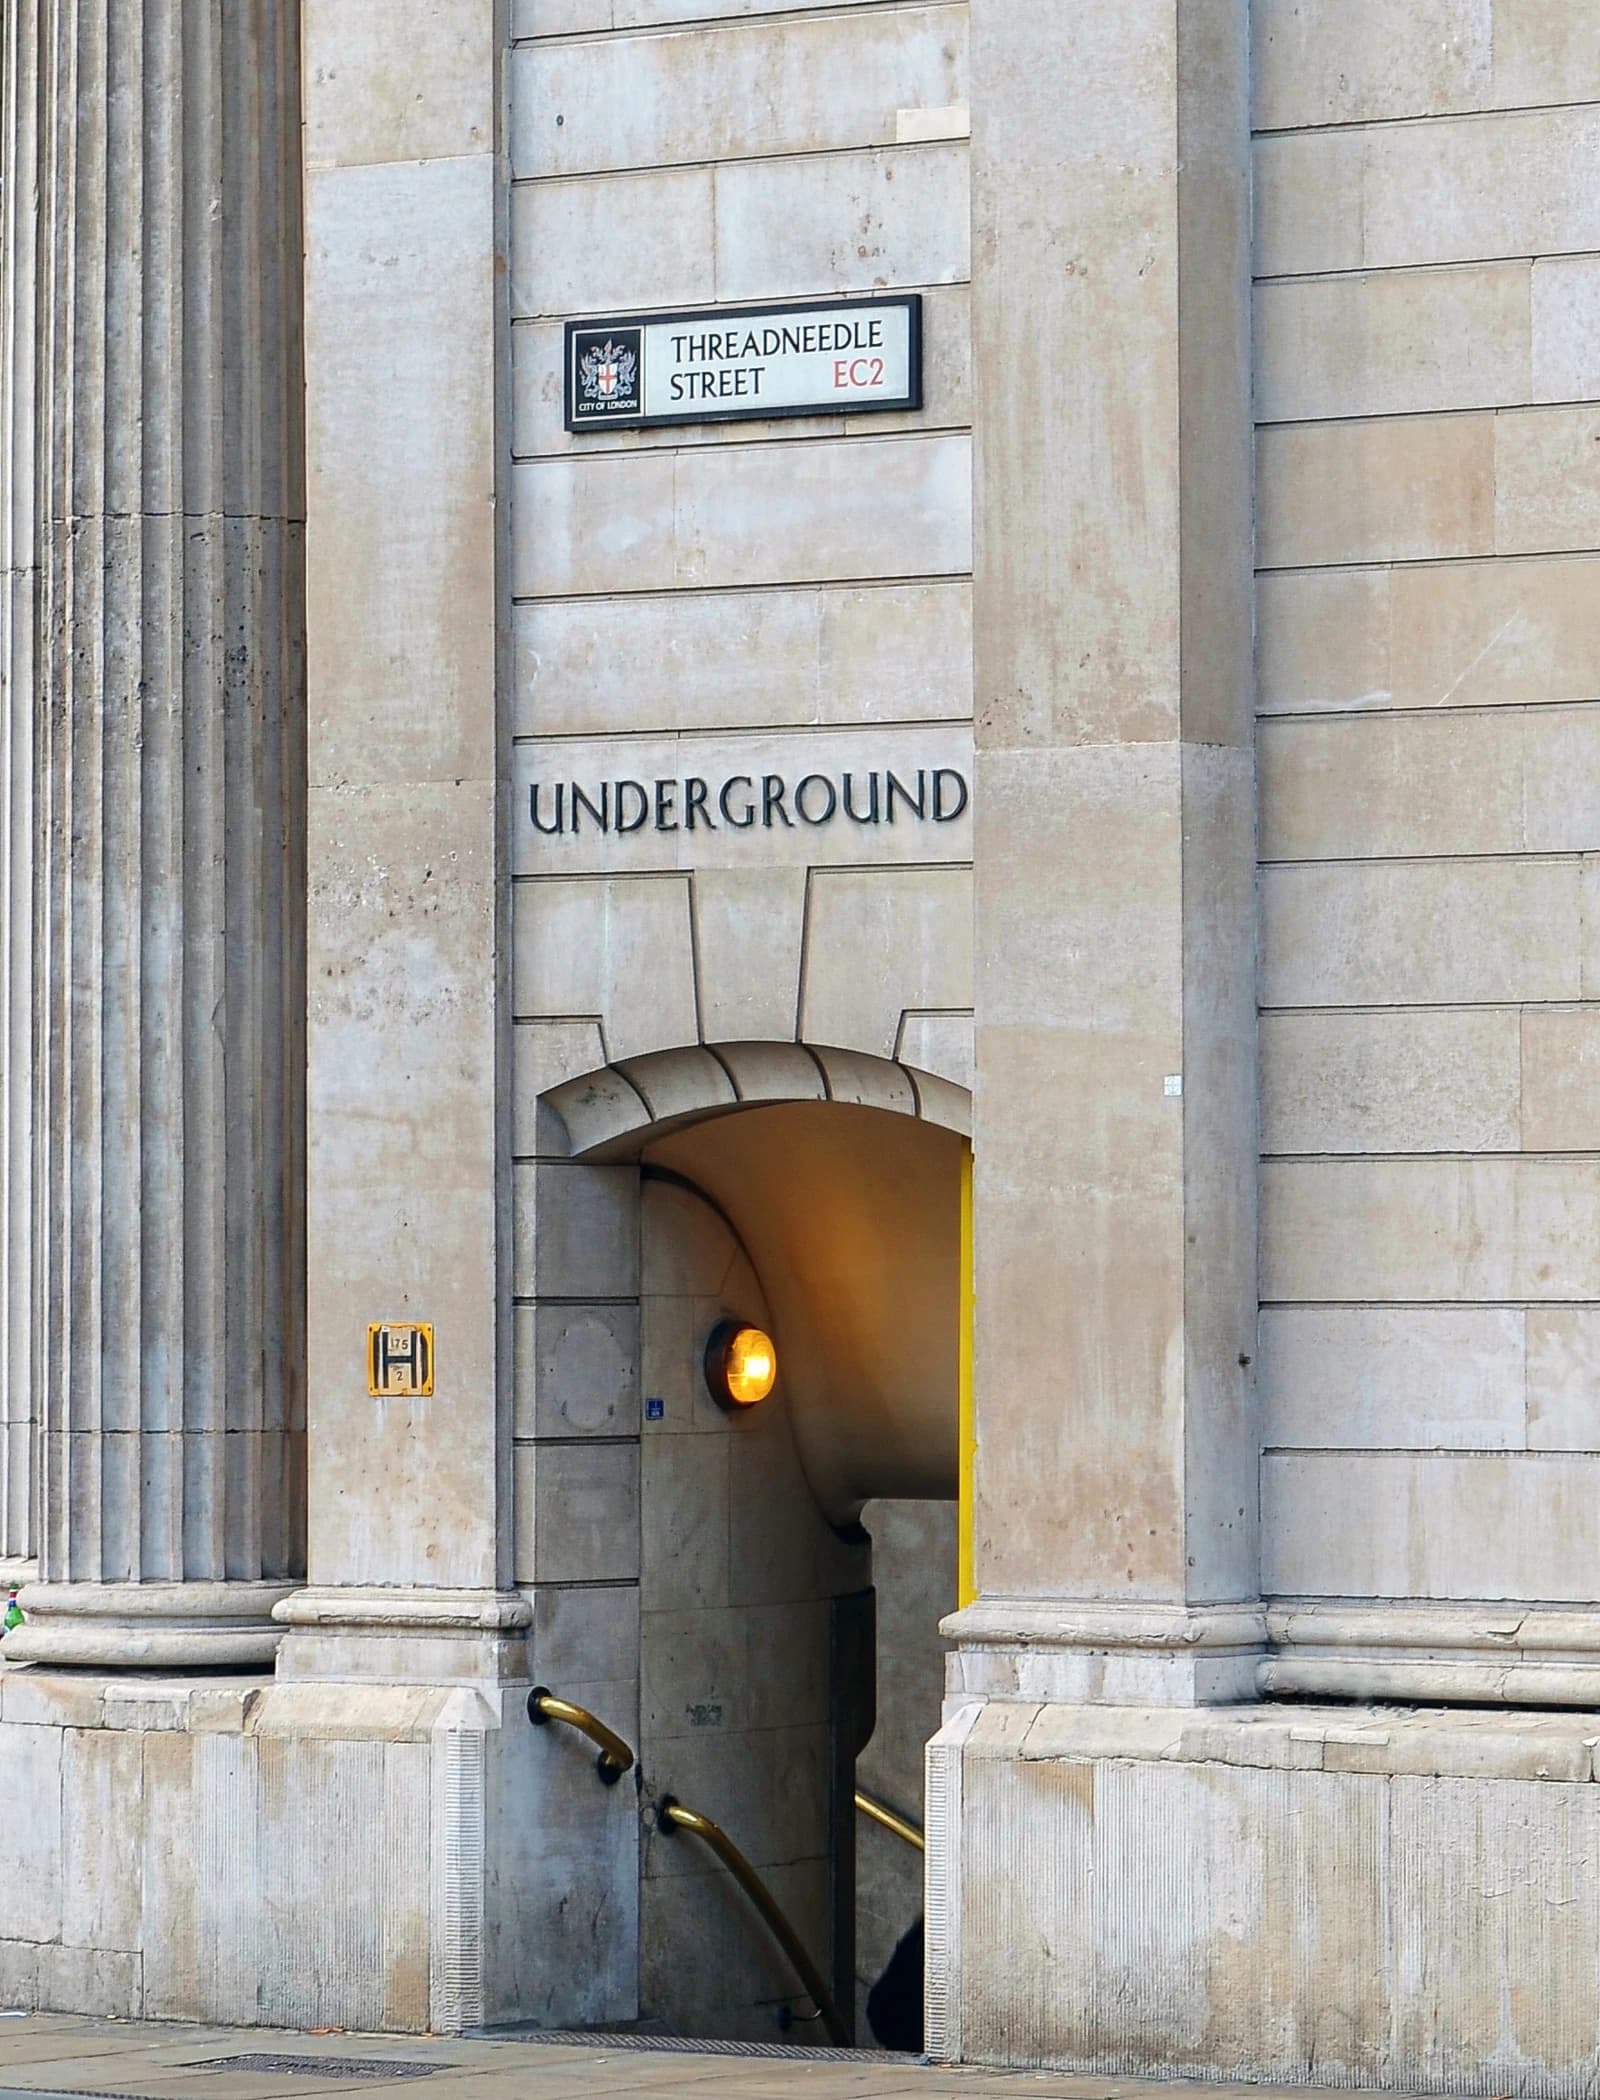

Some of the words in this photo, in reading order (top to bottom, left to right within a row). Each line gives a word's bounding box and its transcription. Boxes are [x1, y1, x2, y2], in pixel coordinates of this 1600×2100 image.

[670, 319, 884, 363] THREADNEEDLE
[670, 366, 766, 400] STREET
[833, 358, 884, 388] EC2
[578, 402, 596, 411] CITY
[596, 401, 606, 410] OF
[607, 400, 638, 410] LONDON
[528, 767, 969, 835] UNDERGROUND
[396, 1371, 404, 1382] 2
